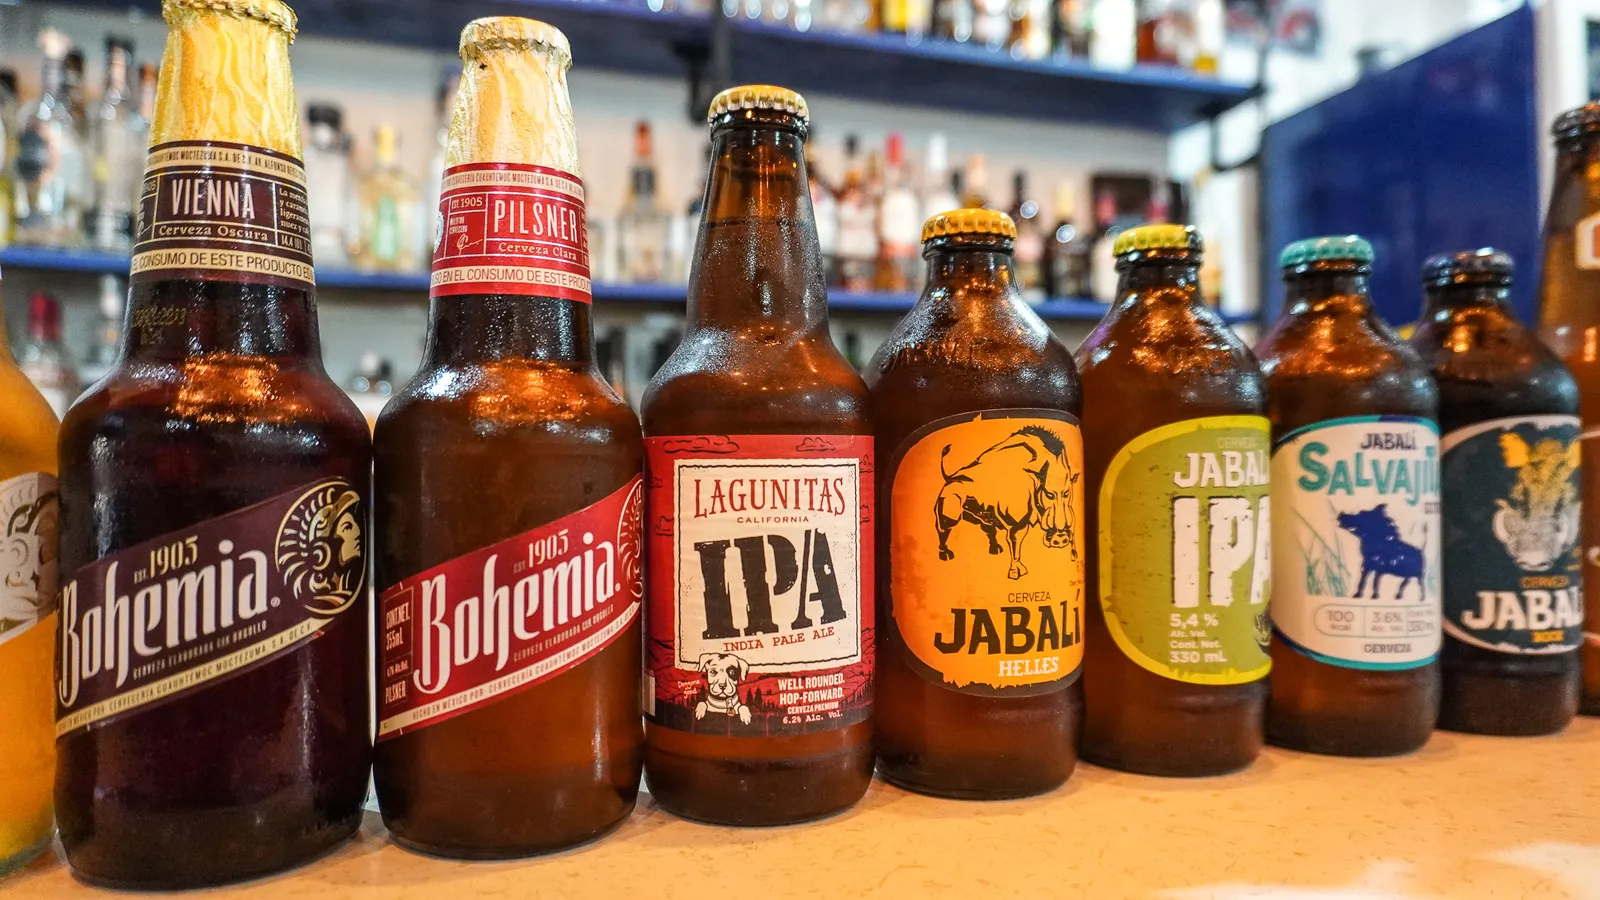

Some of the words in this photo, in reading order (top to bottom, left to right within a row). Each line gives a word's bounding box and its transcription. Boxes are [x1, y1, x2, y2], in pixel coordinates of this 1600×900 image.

[172, 178, 255, 220] VIENNA
[461, 196, 483, 208] 1905
[493, 199, 578, 244] PILSNER
[159, 224, 212, 237] Cerveza
[217, 224, 268, 242] Oscura
[498, 242, 549, 256] Cerveza
[552, 246, 578, 262] Clara
[139, 251, 187, 269] CONSUMO
[190, 252, 207, 265] DE
[210, 252, 244, 267] ESTE
[246, 255, 302, 277] PRODUCTO
[443, 270, 453, 283] EN
[455, 269, 465, 281] EL
[467, 267, 524, 282] CONSUMO
[527, 269, 542, 283] DE
[544, 271, 568, 286] ESTE
[1173, 449, 1270, 490] JABAL
[693, 477, 846, 519] LAGUNITAS
[737, 516, 809, 524] CALIFORNIA
[150, 535, 199, 579] 1905
[528, 528, 569, 568] 1905
[693, 527, 847, 640] IPA
[1007, 591, 1052, 604] CERVEZA
[1327, 609, 1355, 622] 100
[1461, 586, 1584, 631] JABAL
[58, 540, 269, 708] Bohemia
[933, 588, 1082, 655] JABALÍ
[1169, 613, 1199, 629] 5,4
[1203, 613, 1220, 627] %
[723, 639, 764, 652] INDIA
[773, 633, 805, 648] PALE
[812, 626, 835, 640] ALE
[1169, 630, 1189, 638] Alc.
[1169, 640, 1199, 649] Cont.
[1364, 643, 1412, 654] CERVEZA
[215, 644, 266, 672] MOCTEZUMA
[1169, 651, 1200, 663] 330
[1204, 650, 1228, 663] mL
[997, 656, 1060, 678] HELLES
[777, 677, 804, 691] WELL
[805, 673, 846, 689] ROUNDED.
[779, 686, 845, 705] HOP-FORWARD.
[782, 715, 802, 725] 6.2%
[805, 713, 824, 723] Alc.
[828, 709, 844, 719] Vol.
[787, 705, 813, 715] CERVEZA
